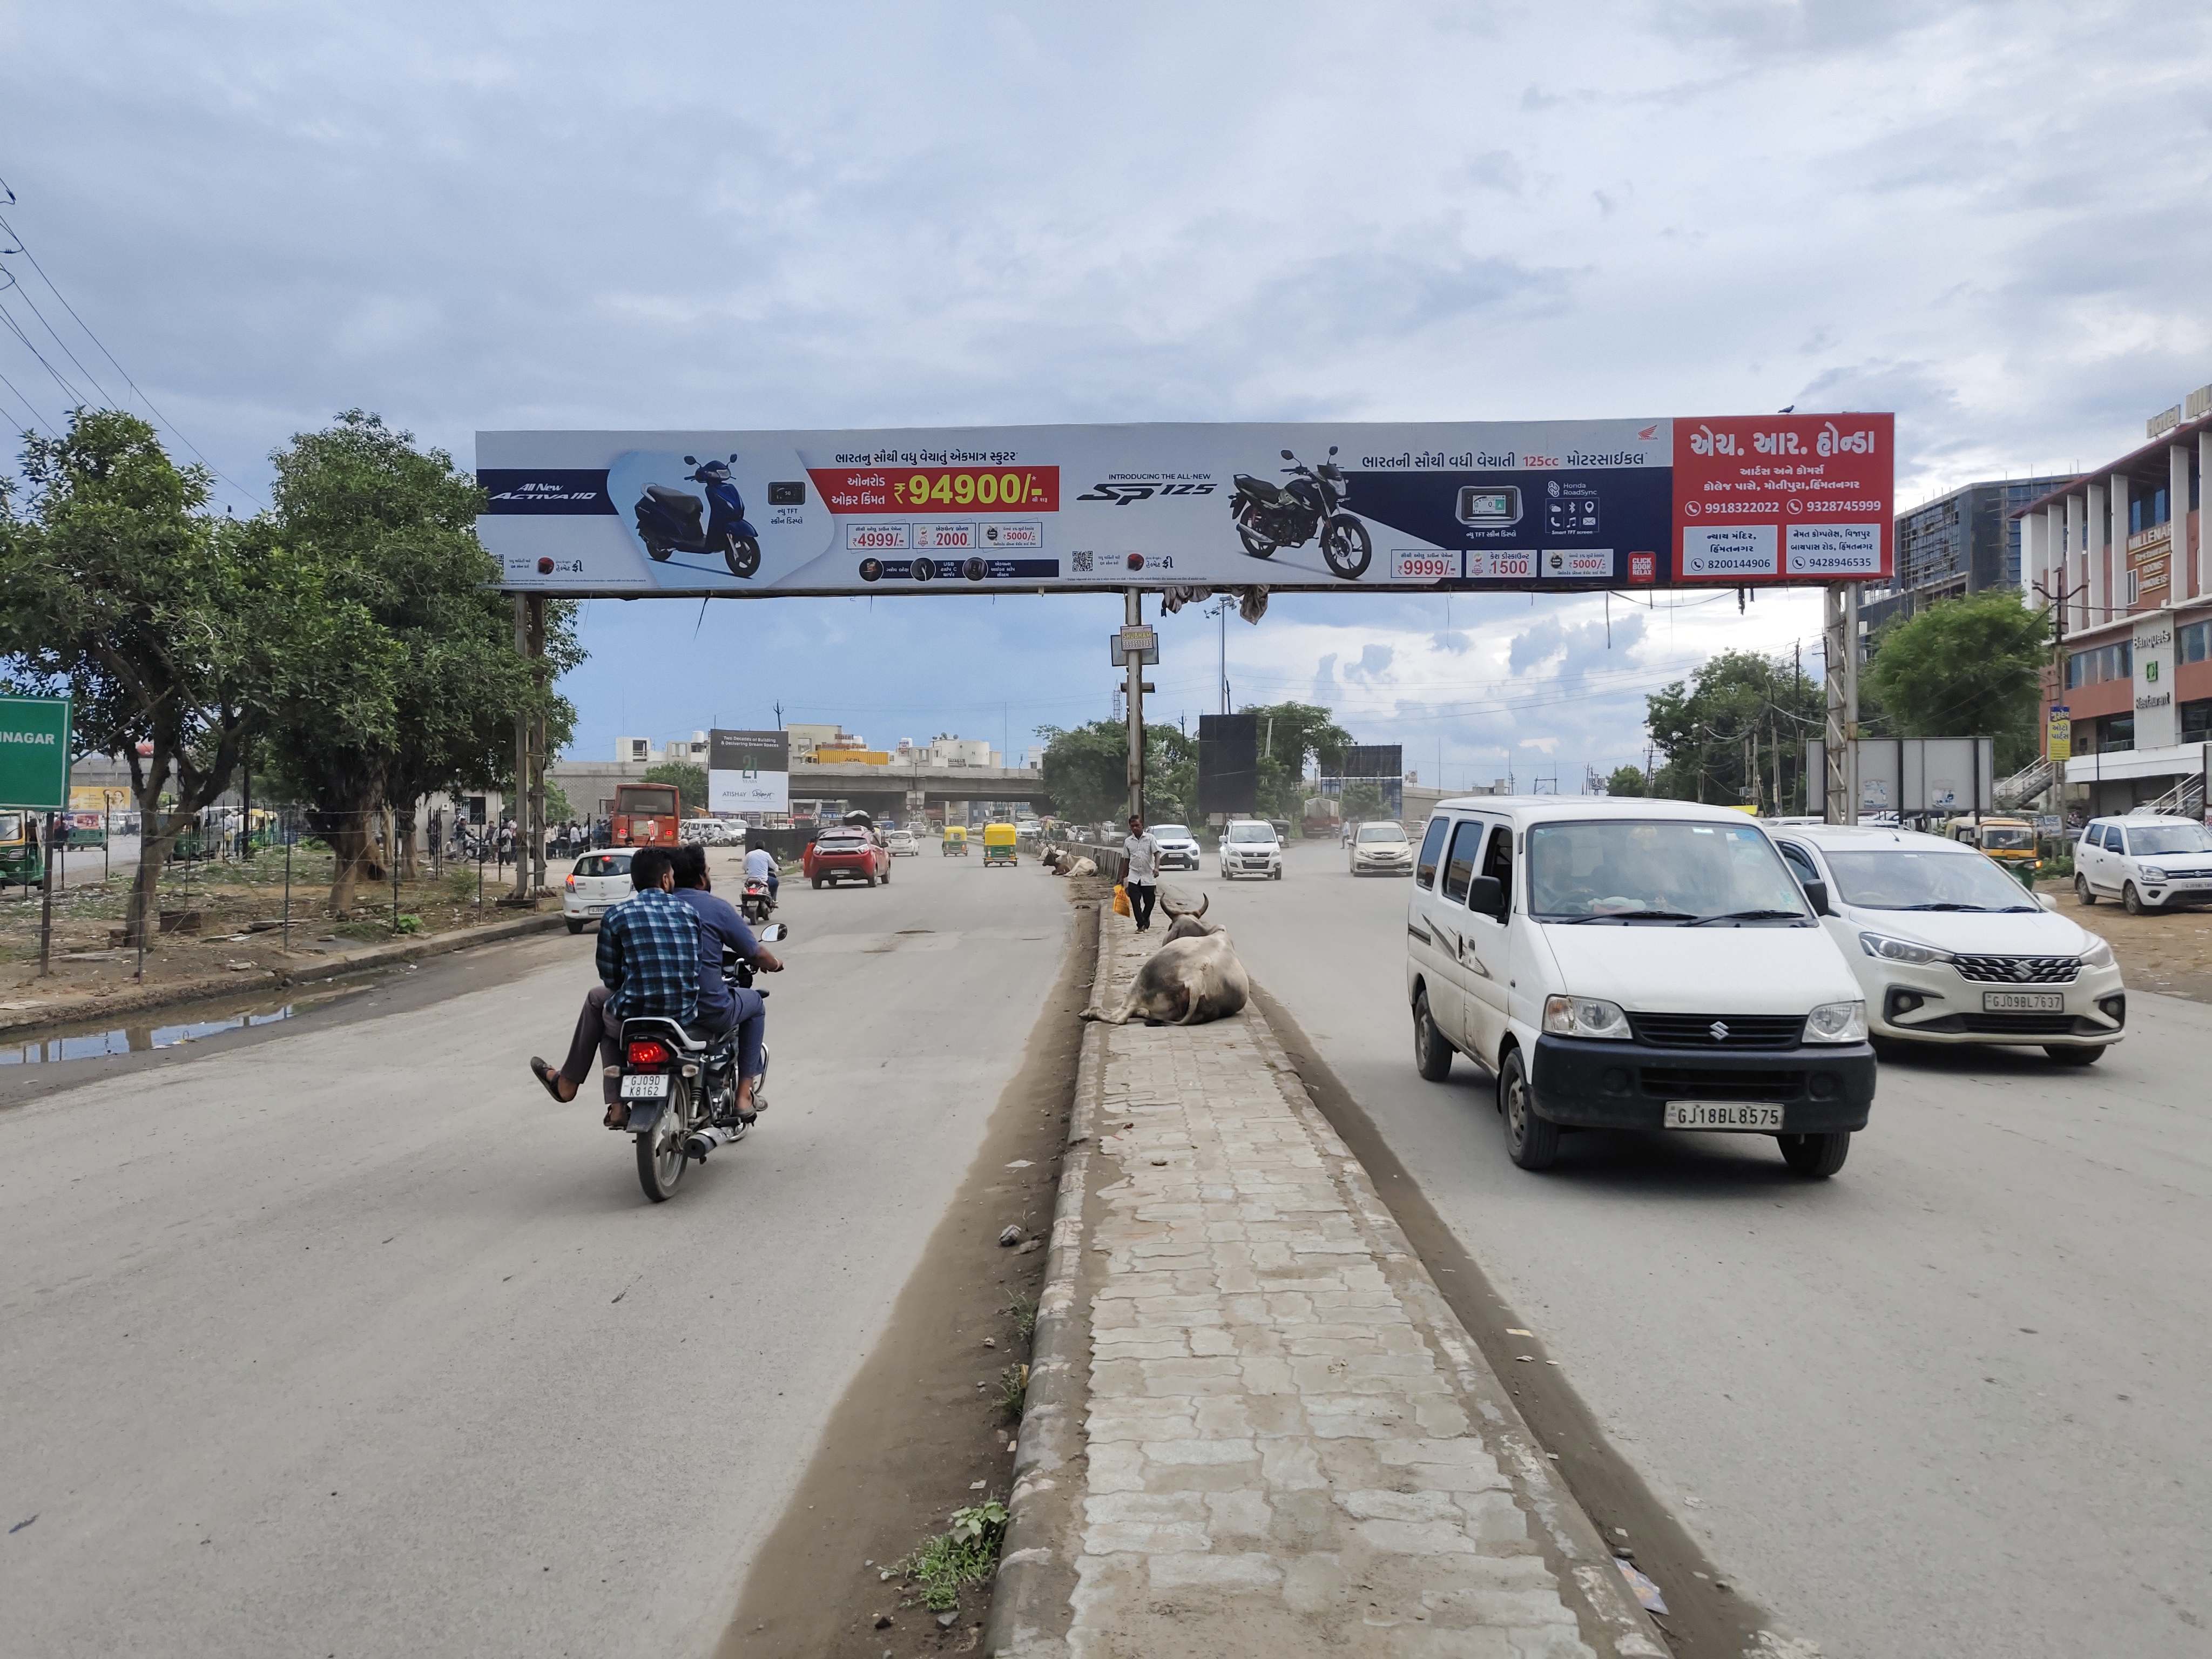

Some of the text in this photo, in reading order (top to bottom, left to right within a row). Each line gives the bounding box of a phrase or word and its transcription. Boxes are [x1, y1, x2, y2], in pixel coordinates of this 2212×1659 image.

[2147, 404, 2181, 439] Hotel
[1690, 421, 1874, 457] એચ. આર. હોન્ડા
[874, 449, 898, 463] સૌથી
[901, 451, 918, 465] વધુ
[920, 449, 948, 464] વેચાતું
[949, 451, 987, 462] એકમાત્ર
[1362, 452, 1410, 468] ભારતની
[1415, 451, 1445, 468] સૌથી
[1477, 451, 1515, 467] વેચાતી
[1523, 456, 1559, 467] 125cc
[1740, 464, 1824, 476] આર્ટસ અને કોમર્સ
[847, 474, 886, 486] ઓનરોડ
[1703, 481, 1731, 491] કોલેજ
[1735, 481, 1761, 491] પાસે,
[831, 490, 885, 505] ઓફર કિંમત
[1076, 483, 1218, 505] SP 125
[1705, 502, 1779, 514] 9918322022
[1806, 501, 1881, 512] 9328745999
[1845, 529, 1870, 539] વિજાપુર
[1710, 544, 1754, 553] હિંમતનગર
[1822, 542, 1836, 551] રોડ,
[1839, 542, 1873, 551] હિંમતનગર
[1708, 559, 1770, 569] 8200144906
[1809, 558, 1871, 567] 9428946535
[1123, 631, 1151, 639] SHUBHAM
[2134, 630, 2170, 648] Banquets
[1123, 640, 1152, 648] 9898512345
[743, 755, 757, 779] 21
[1993, 996, 2060, 1008] GJ09BL7637
[631, 1076, 660, 1085] GJ09D
[630, 1087, 659, 1096] K8162
[1678, 1108, 1778, 1124] GJ18BL8575
